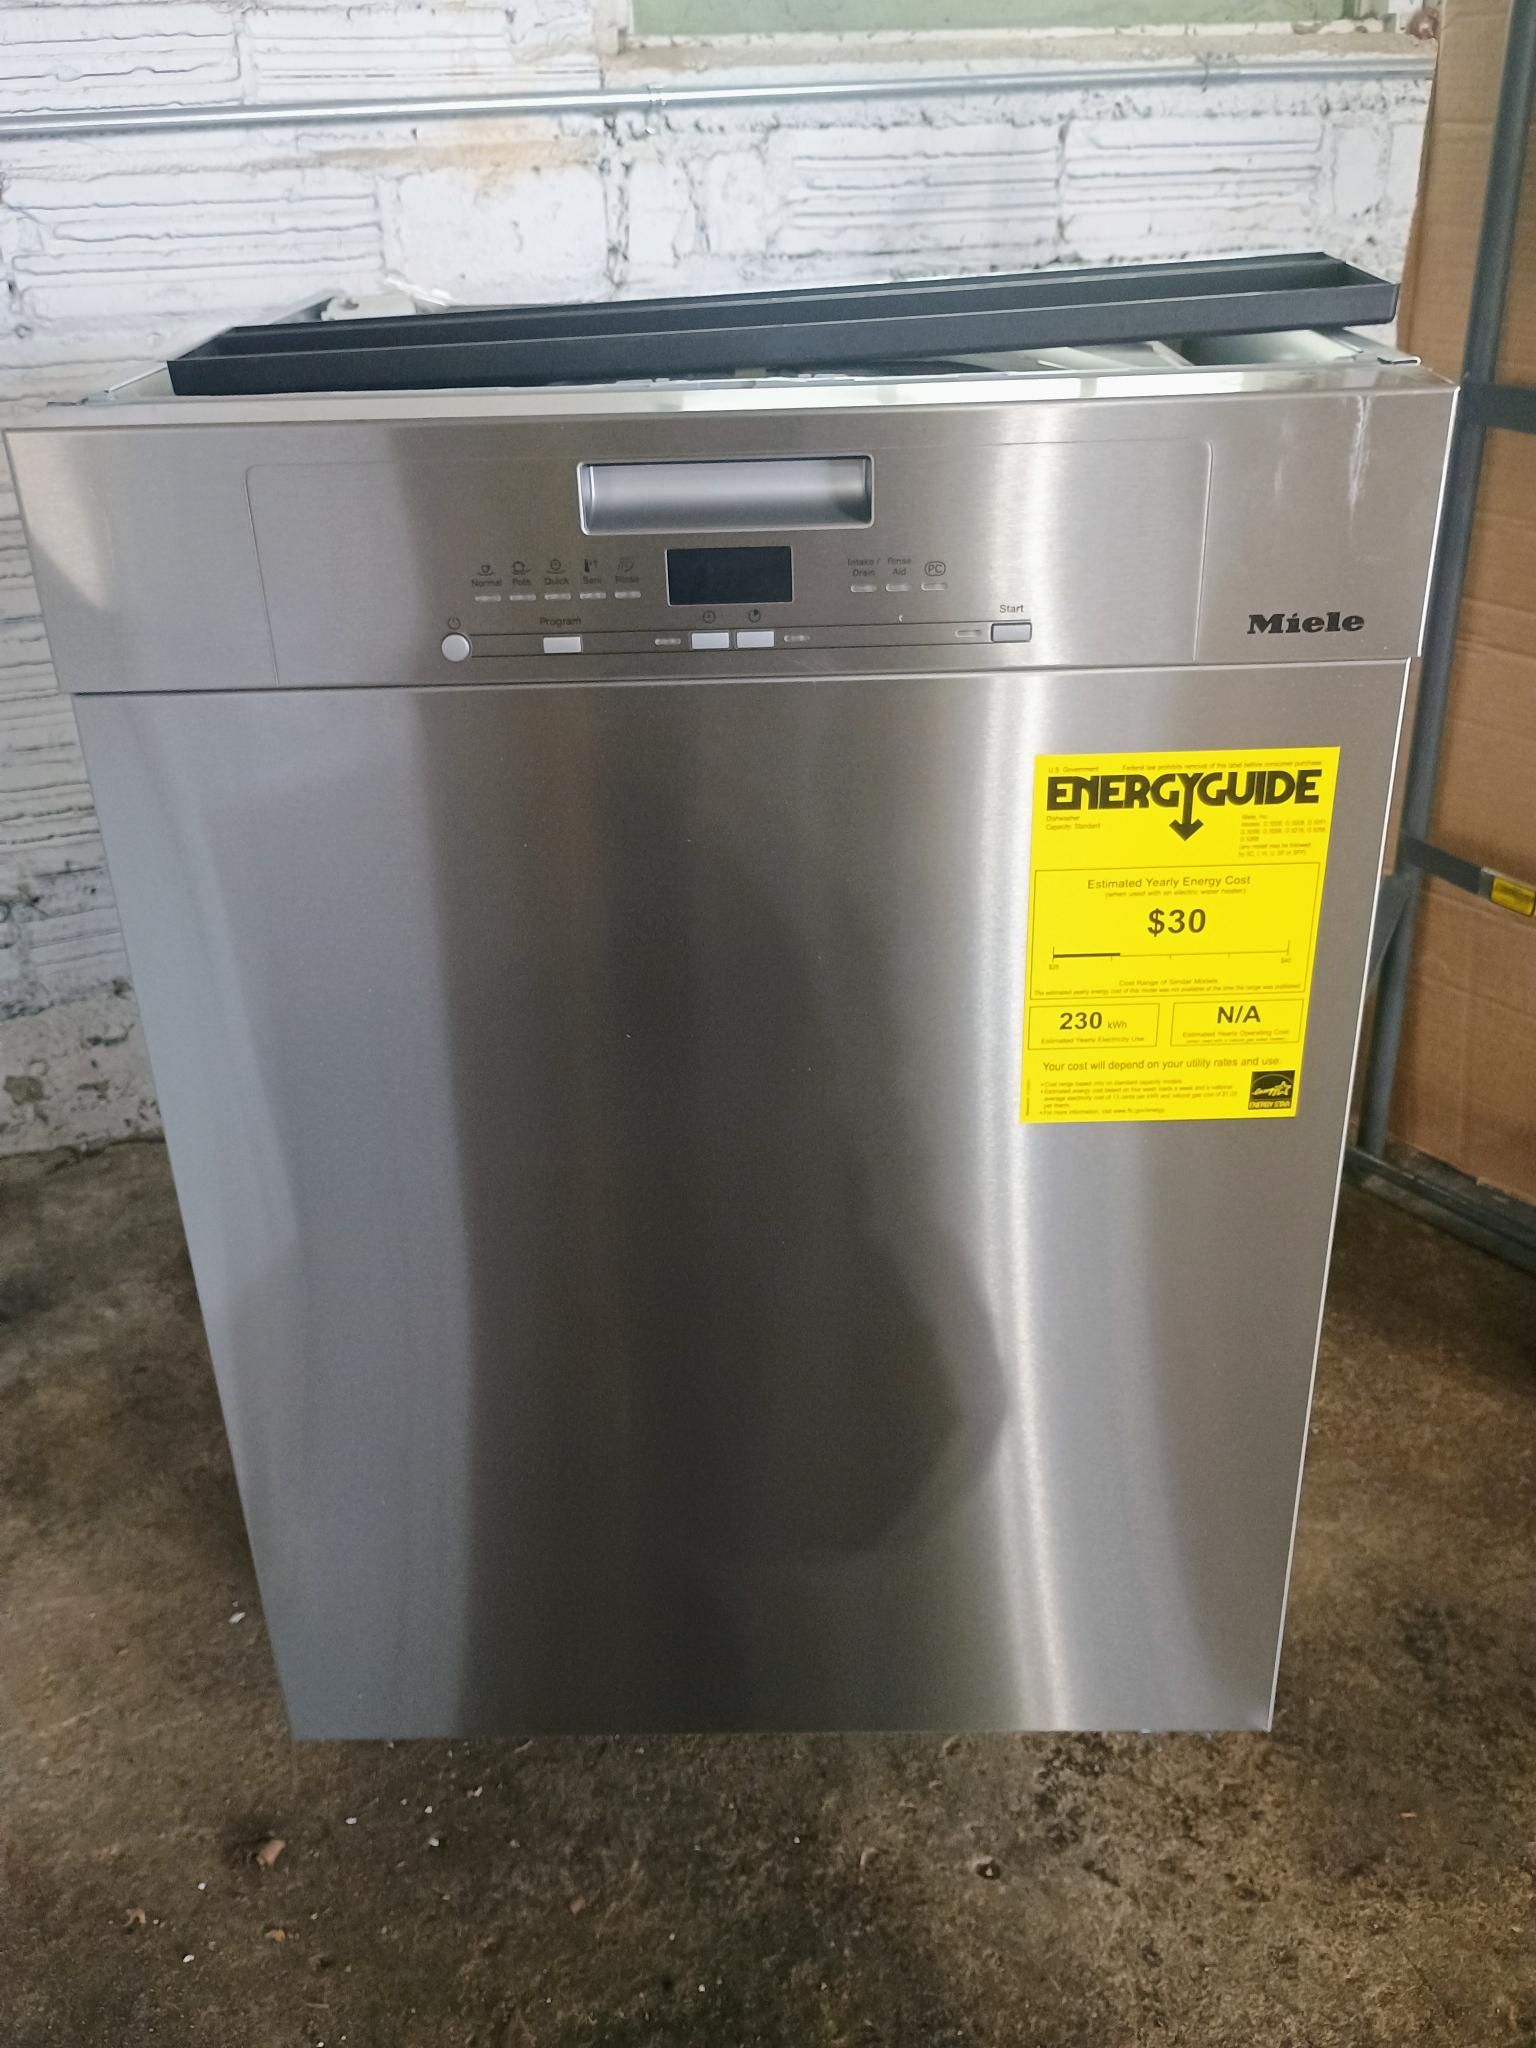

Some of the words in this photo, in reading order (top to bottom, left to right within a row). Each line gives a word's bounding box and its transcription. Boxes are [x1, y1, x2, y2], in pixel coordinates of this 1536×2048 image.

[852, 568, 876, 577] Drain
[892, 567, 907, 577] Aid
[927, 564, 943, 575] PC
[471, 578, 503, 588] Normal
[511, 577, 532, 587] Pots
[544, 576, 570, 586] Quick
[999, 603, 1025, 614] Start
[539, 616, 582, 627] Program
[1246, 611, 1366, 635] Miele
[1047, 769, 1323, 812] ENERGYGUIDE
[1087, 878, 1143, 890] Estimated
[1145, 877, 1180, 889] Yearly
[1182, 876, 1222, 889] Energy
[1224, 875, 1251, 886] Cost
[1146, 907, 1207, 938] $30
[1217, 1004, 1261, 1024] N/A
[1058, 1011, 1103, 1031] 230
[1107, 1020, 1128, 1030] kWh
[1042, 1061, 1065, 1072] Your
[1067, 1061, 1088, 1071] cost
[1090, 1060, 1106, 1071] will
[1107, 1059, 1145, 1072] depend
[1146, 1060, 1159, 1069] on
[1161, 1060, 1184, 1071] your
[1185, 1058, 1211, 1069] utility
[1213, 1057, 1238, 1068] rates
[1240, 1057, 1259, 1067] and
